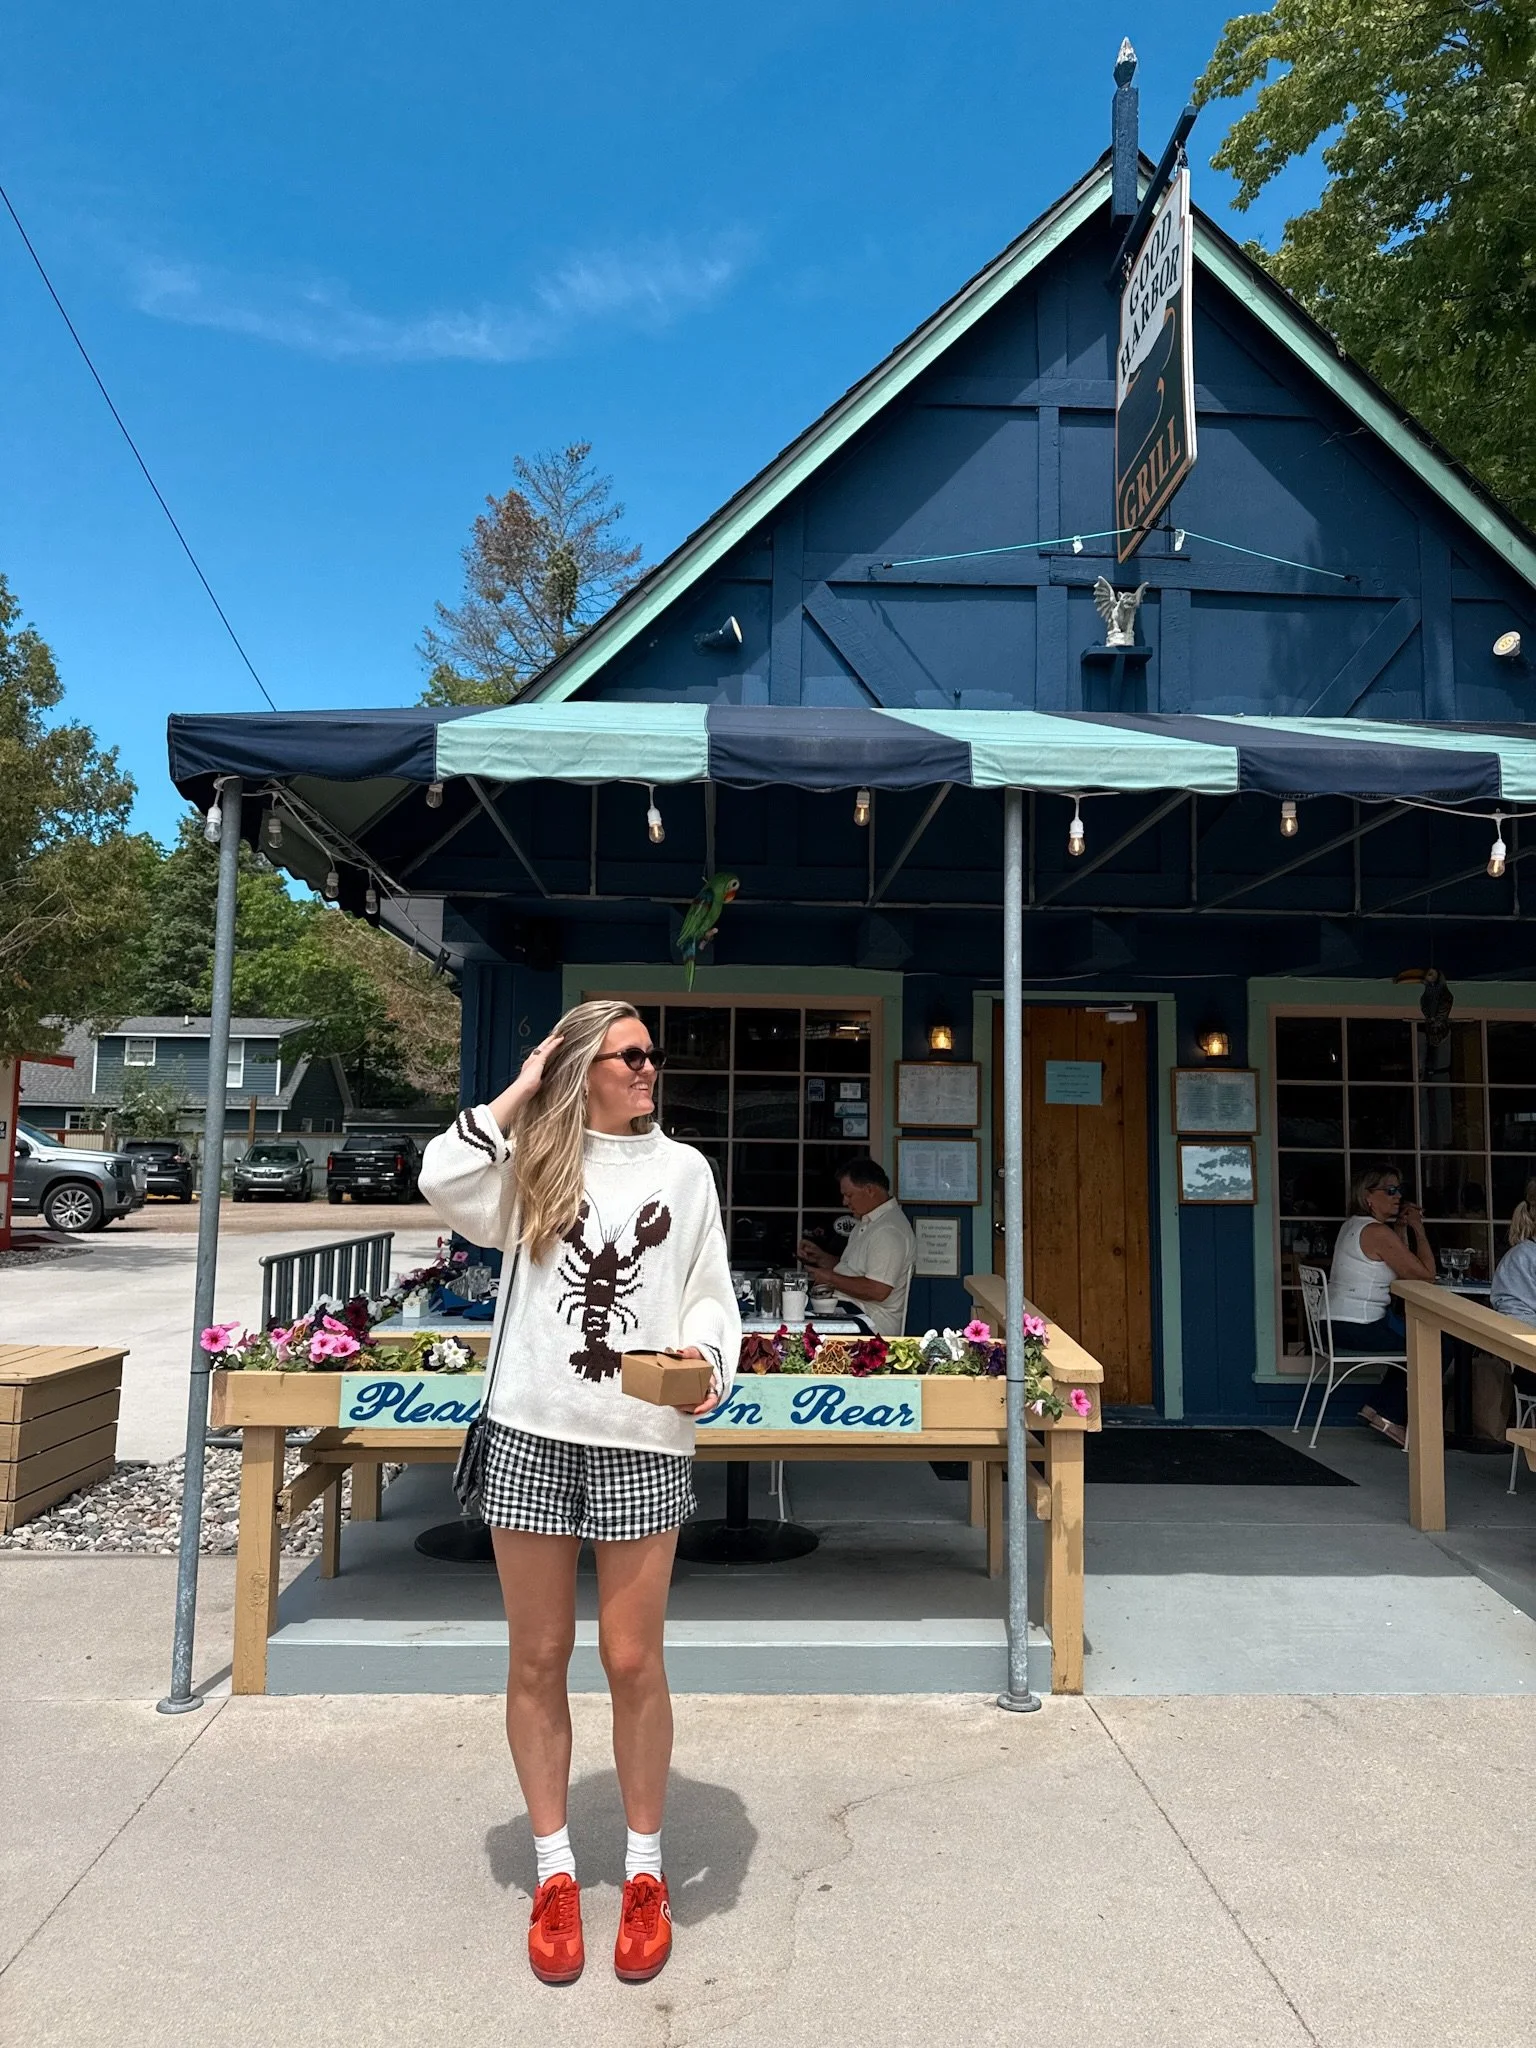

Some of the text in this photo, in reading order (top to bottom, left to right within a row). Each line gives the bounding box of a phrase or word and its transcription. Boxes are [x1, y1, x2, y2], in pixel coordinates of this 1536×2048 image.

[1120, 244, 1180, 379] HARBOR
[1129, 210, 1173, 316] GOOD
[1123, 414, 1181, 529] GRILL
[349, 1381, 482, 1424] Plea
[791, 1383, 916, 1427] Rear
